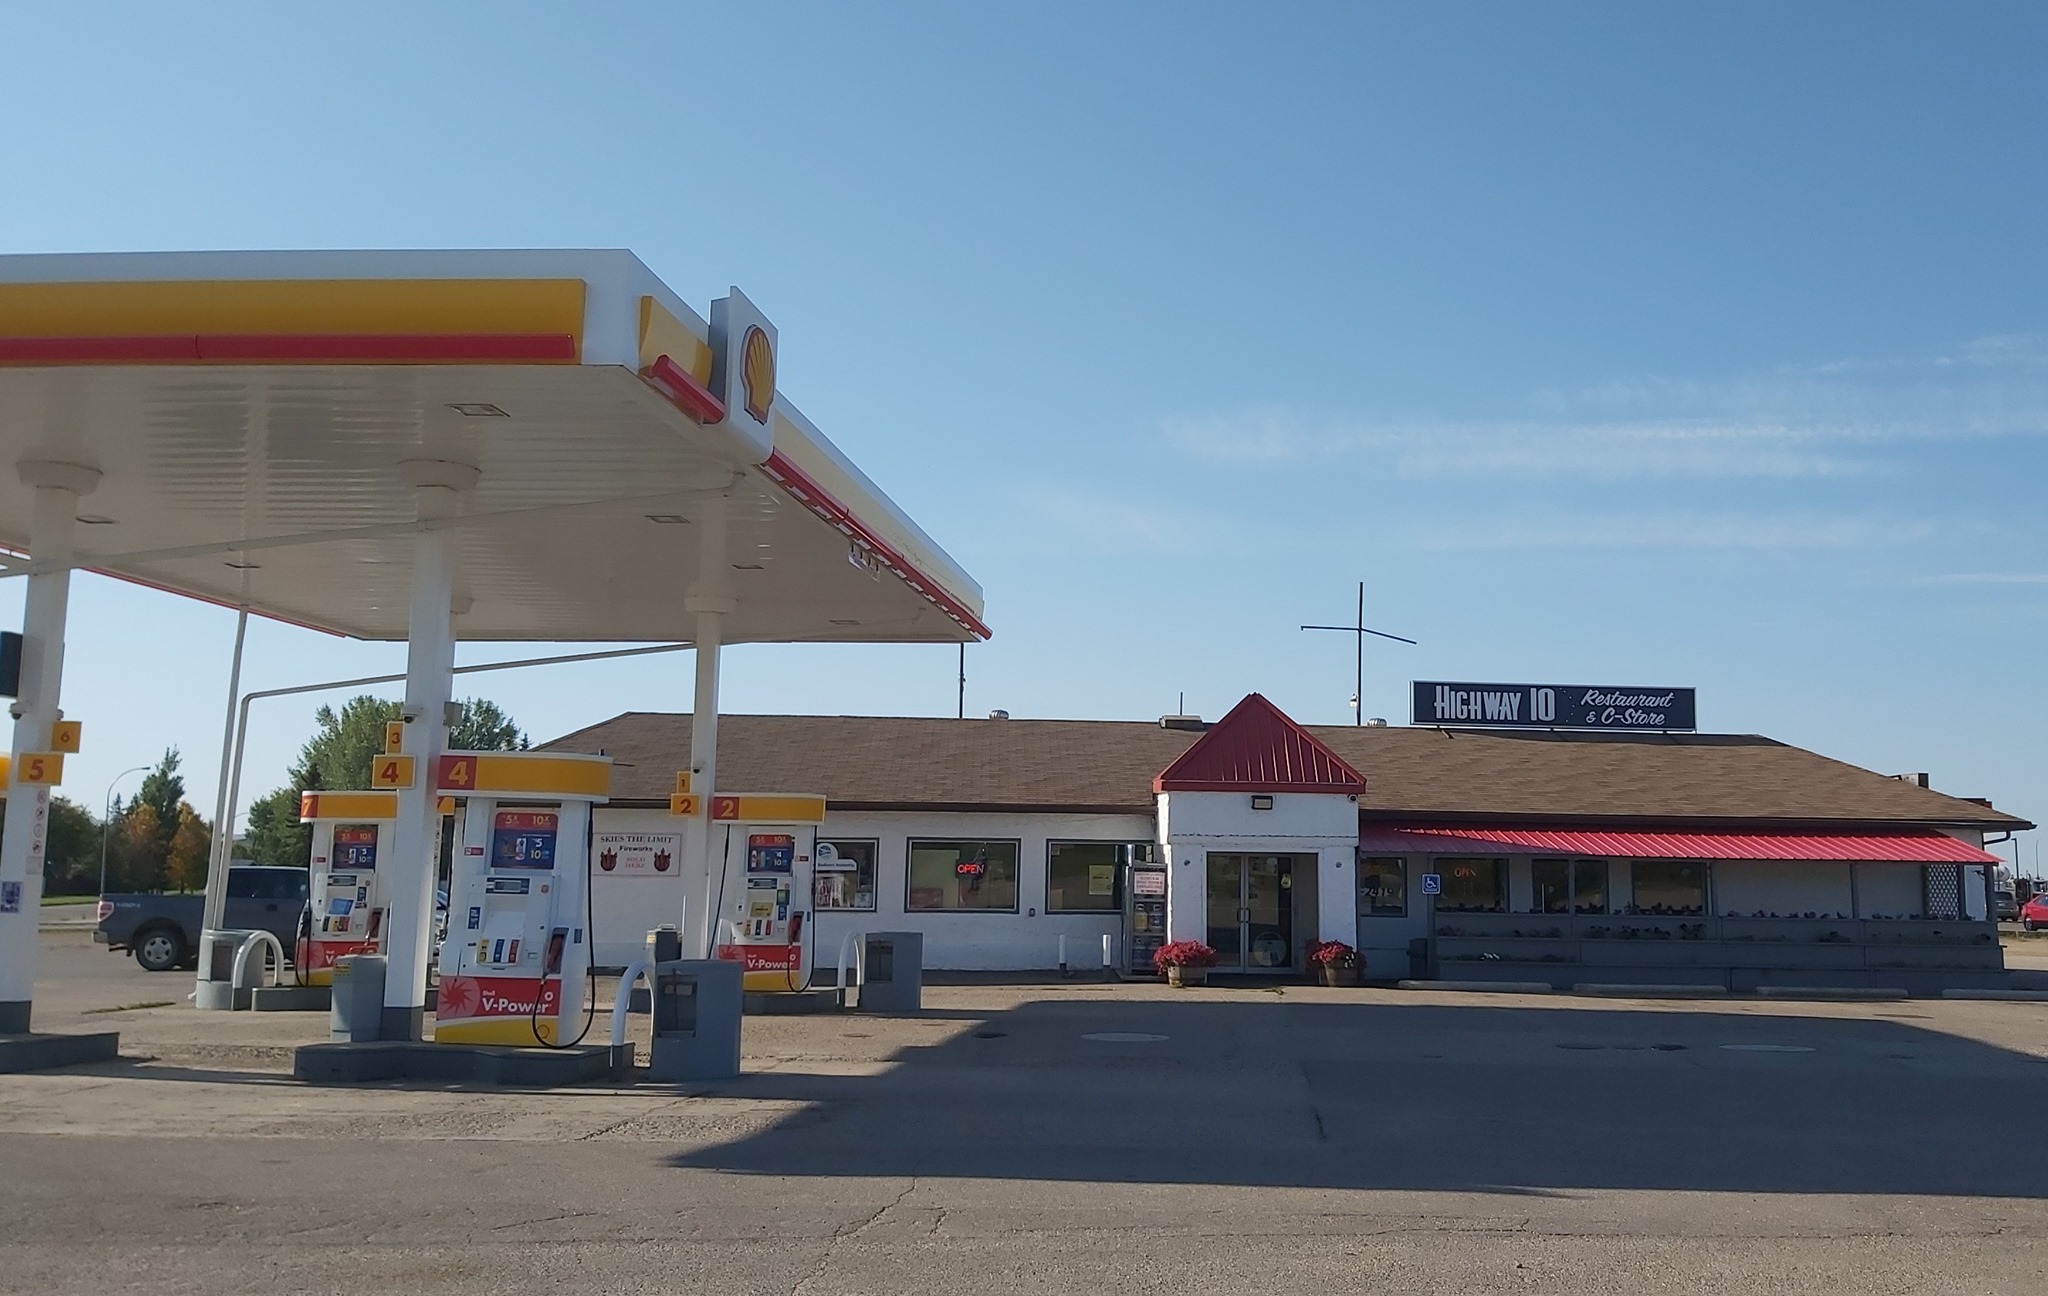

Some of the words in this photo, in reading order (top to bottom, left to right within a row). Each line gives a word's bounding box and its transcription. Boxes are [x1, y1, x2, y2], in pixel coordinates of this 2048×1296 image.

[1434, 685, 1521, 720] HIGHWAY
[1530, 687, 1556, 721] 10
[1580, 689, 1674, 707] Restaurant
[1585, 711, 1597, 723] &
[1601, 707, 1665, 725] C-Store
[60, 731, 70, 743] 6
[391, 732, 400, 744] 3
[28, 758, 44, 781] 5
[381, 762, 399, 783] 4
[448, 761, 468, 786] 4
[303, 798, 314, 816] 7
[680, 798, 692, 814] 2
[721, 800, 734, 817] 2
[600, 835, 625, 843] SKIES
[627, 835, 645, 843] THE
[647, 835, 674, 843] LIMIT
[957, 864, 984, 874] OPEN
[482, 998, 549, 1014] V-Power
